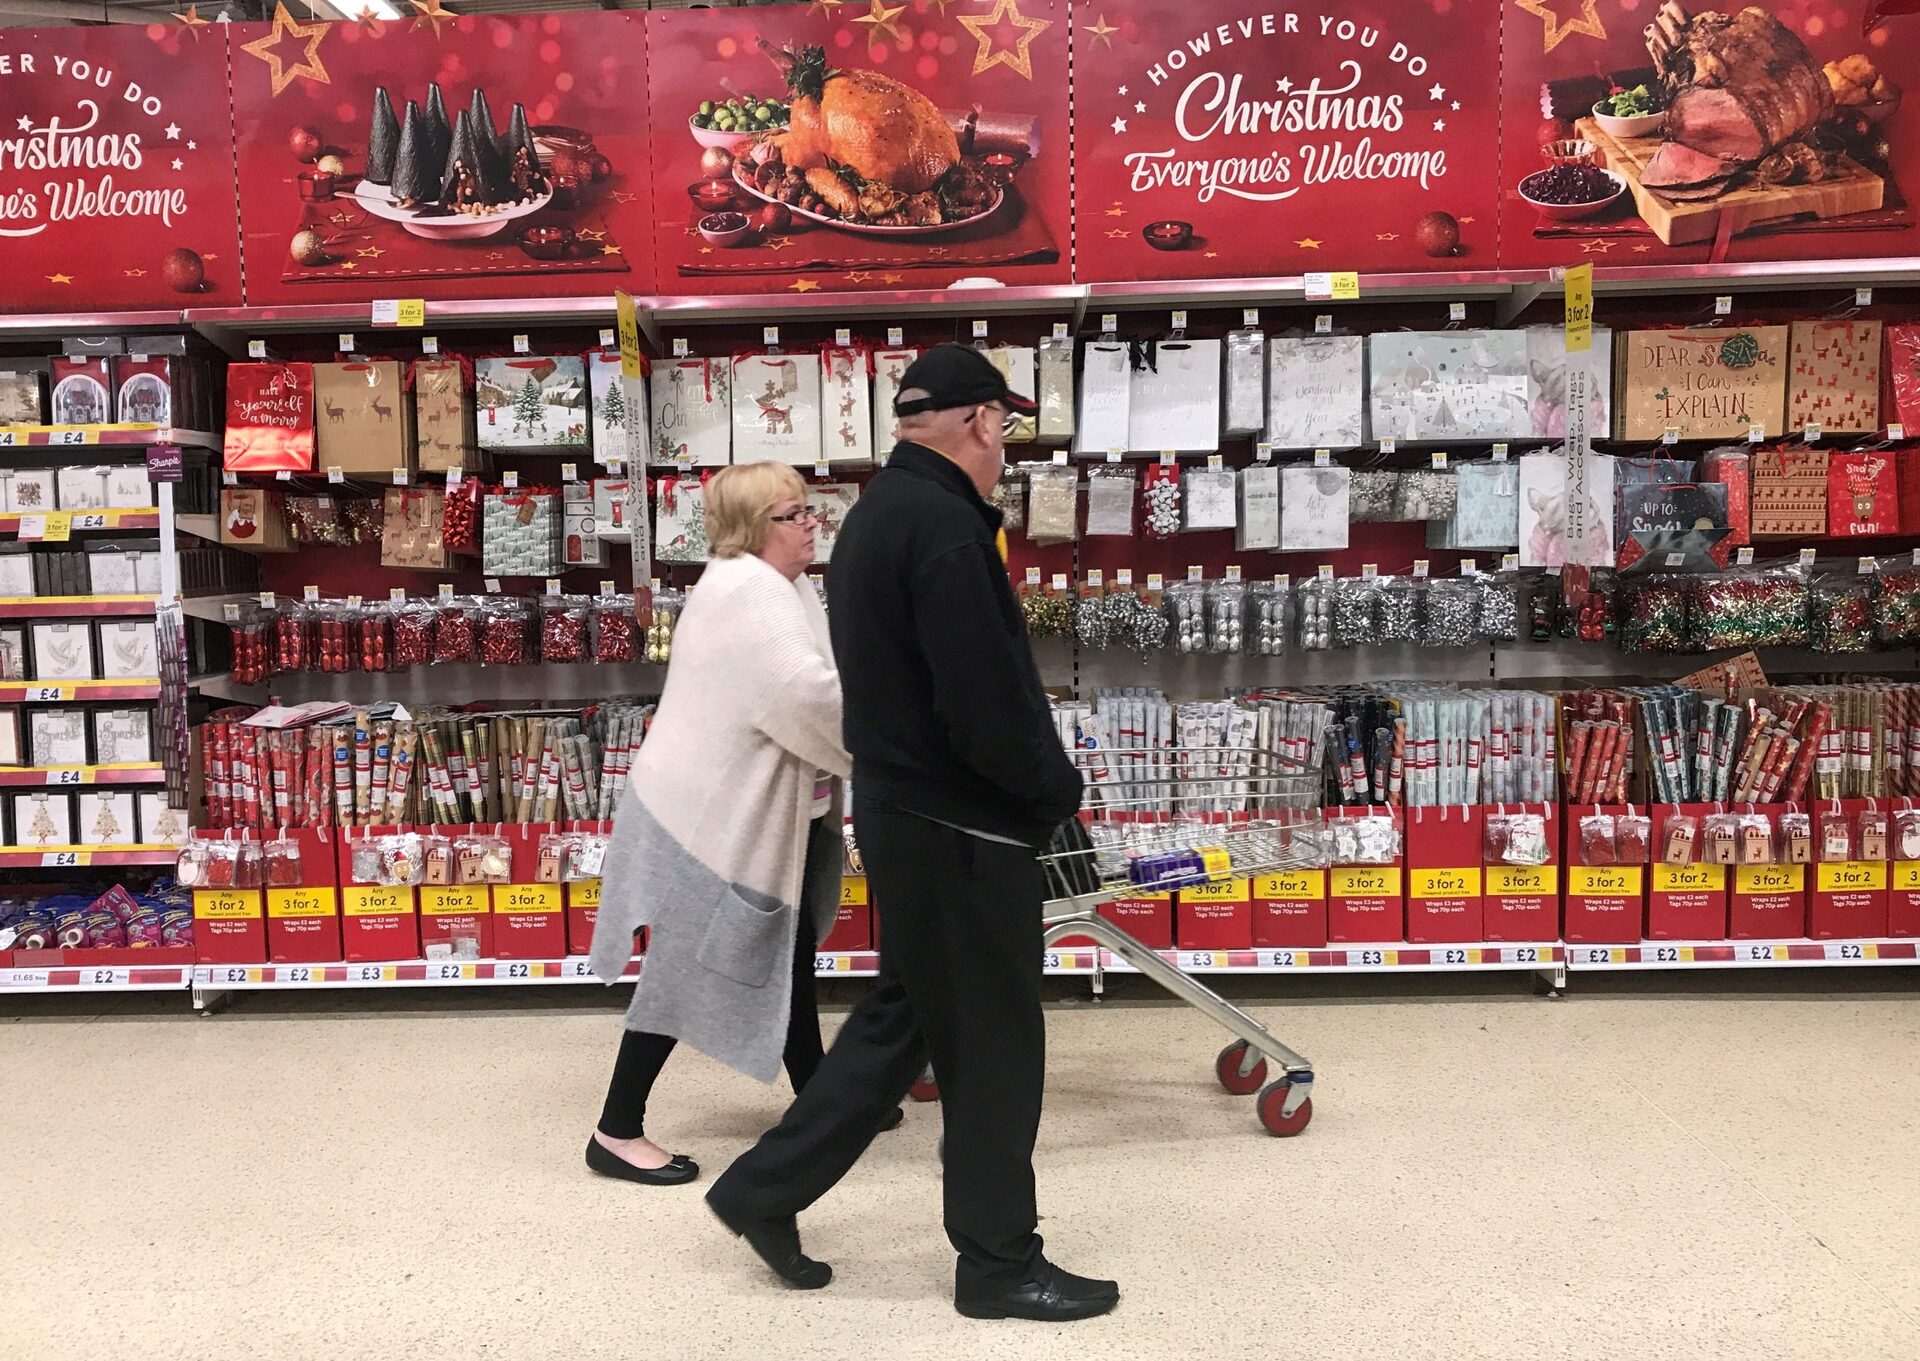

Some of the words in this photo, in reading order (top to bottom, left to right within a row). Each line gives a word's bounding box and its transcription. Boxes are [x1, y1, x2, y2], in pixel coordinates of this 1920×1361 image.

[1146, 13, 1299, 86] HOWEVER
[1320, 15, 1379, 48] YOU
[1389, 41, 1427, 76] DO
[54, 55, 112, 87] YOU
[123, 82, 161, 116] DO
[1175, 59, 1404, 142] Christmas
[1123, 147, 1300, 203] Everyone's
[1299, 136, 1447, 191] Welcome
[44, 174, 187, 228] Welcome
[1568, 308, 1572, 323] 3
[1573, 306, 1583, 321] for
[1585, 304, 1588, 319] 2
[1644, 346, 1691, 368] DEAR
[1684, 373, 1691, 391] I
[1697, 373, 1731, 390] Can
[234, 395, 303, 420] yourself
[1664, 392, 1746, 420] EXPLAIN
[250, 415, 260, 423] a
[64, 432, 83, 444] £4
[1576, 371, 1584, 494] Accessories
[1845, 464, 1867, 474] Sno
[1644, 502, 1658, 516] UP
[1661, 503, 1674, 515] TO
[84, 515, 103, 527] £4
[1849, 522, 1880, 535] fun!
[40, 688, 60, 700] £4
[61, 771, 80, 783] £4
[56, 853, 76, 865] £4
[1503, 877, 1510, 886] 3
[1513, 877, 1530, 886] for
[1533, 876, 1540, 885] 2
[1670, 873, 1678, 883] 3
[1680, 872, 1698, 883] for
[1701, 872, 1708, 882] 2
[1753, 876, 1760, 885] 3
[1763, 875, 1781, 885] for
[1783, 875, 1790, 884] 2
[1834, 873, 1841, 882] 3
[1843, 872, 1861, 882] for
[1864, 871, 1871, 881] 2
[1910, 871, 1918, 880] 3
[1270, 881, 1278, 890] 3
[1280, 881, 1298, 890] for
[1300, 881, 1307, 890] 2
[1347, 879, 1354, 888] 3
[1357, 878, 1374, 888] for
[1377, 878, 1384, 887] 2
[1427, 880, 1435, 888] 3
[1437, 879, 1455, 888] for
[1457, 879, 1464, 888] 2
[1587, 878, 1594, 887] 3
[1597, 877, 1615, 887] for
[1617, 877, 1624, 886] 2
[845, 888, 851, 898] 2
[1196, 886, 1203, 894] 3
[1205, 884, 1223, 894] for
[1225, 884, 1232, 893] 2
[210, 901, 217, 910] 3
[219, 901, 236, 910] for
[238, 901, 245, 909] 2
[284, 900, 291, 909] 3
[293, 899, 310, 909] for
[312, 899, 319, 908] 2
[360, 897, 367, 906] 3
[369, 897, 387, 906] for
[389, 896, 396, 905] 2
[437, 897, 444, 906] 3
[447, 896, 464, 906] for
[466, 896, 473, 905] 2
[509, 895, 517, 904] 3
[519, 895, 536, 904] for
[538, 895, 545, 903] 2
[1362, 952, 1381, 964] £3
[1446, 951, 1465, 964] £2
[1517, 949, 1536, 962] £2
[1589, 950, 1609, 963] £2
[1657, 949, 1677, 961] £2
[1752, 946, 1772, 960] £2
[1841, 946, 1861, 958] £2
[816, 958, 834, 970] £2
[1042, 956, 1059, 967] £3
[1193, 953, 1212, 965] £3
[1274, 952, 1293, 965] £2
[228, 969, 246, 982] £2
[290, 969, 309, 981] £2
[361, 967, 380, 980] £3
[441, 965, 460, 978] £2
[509, 965, 528, 977] £2
[13, 974, 34, 982] £1.65
[94, 971, 113, 984] £2
